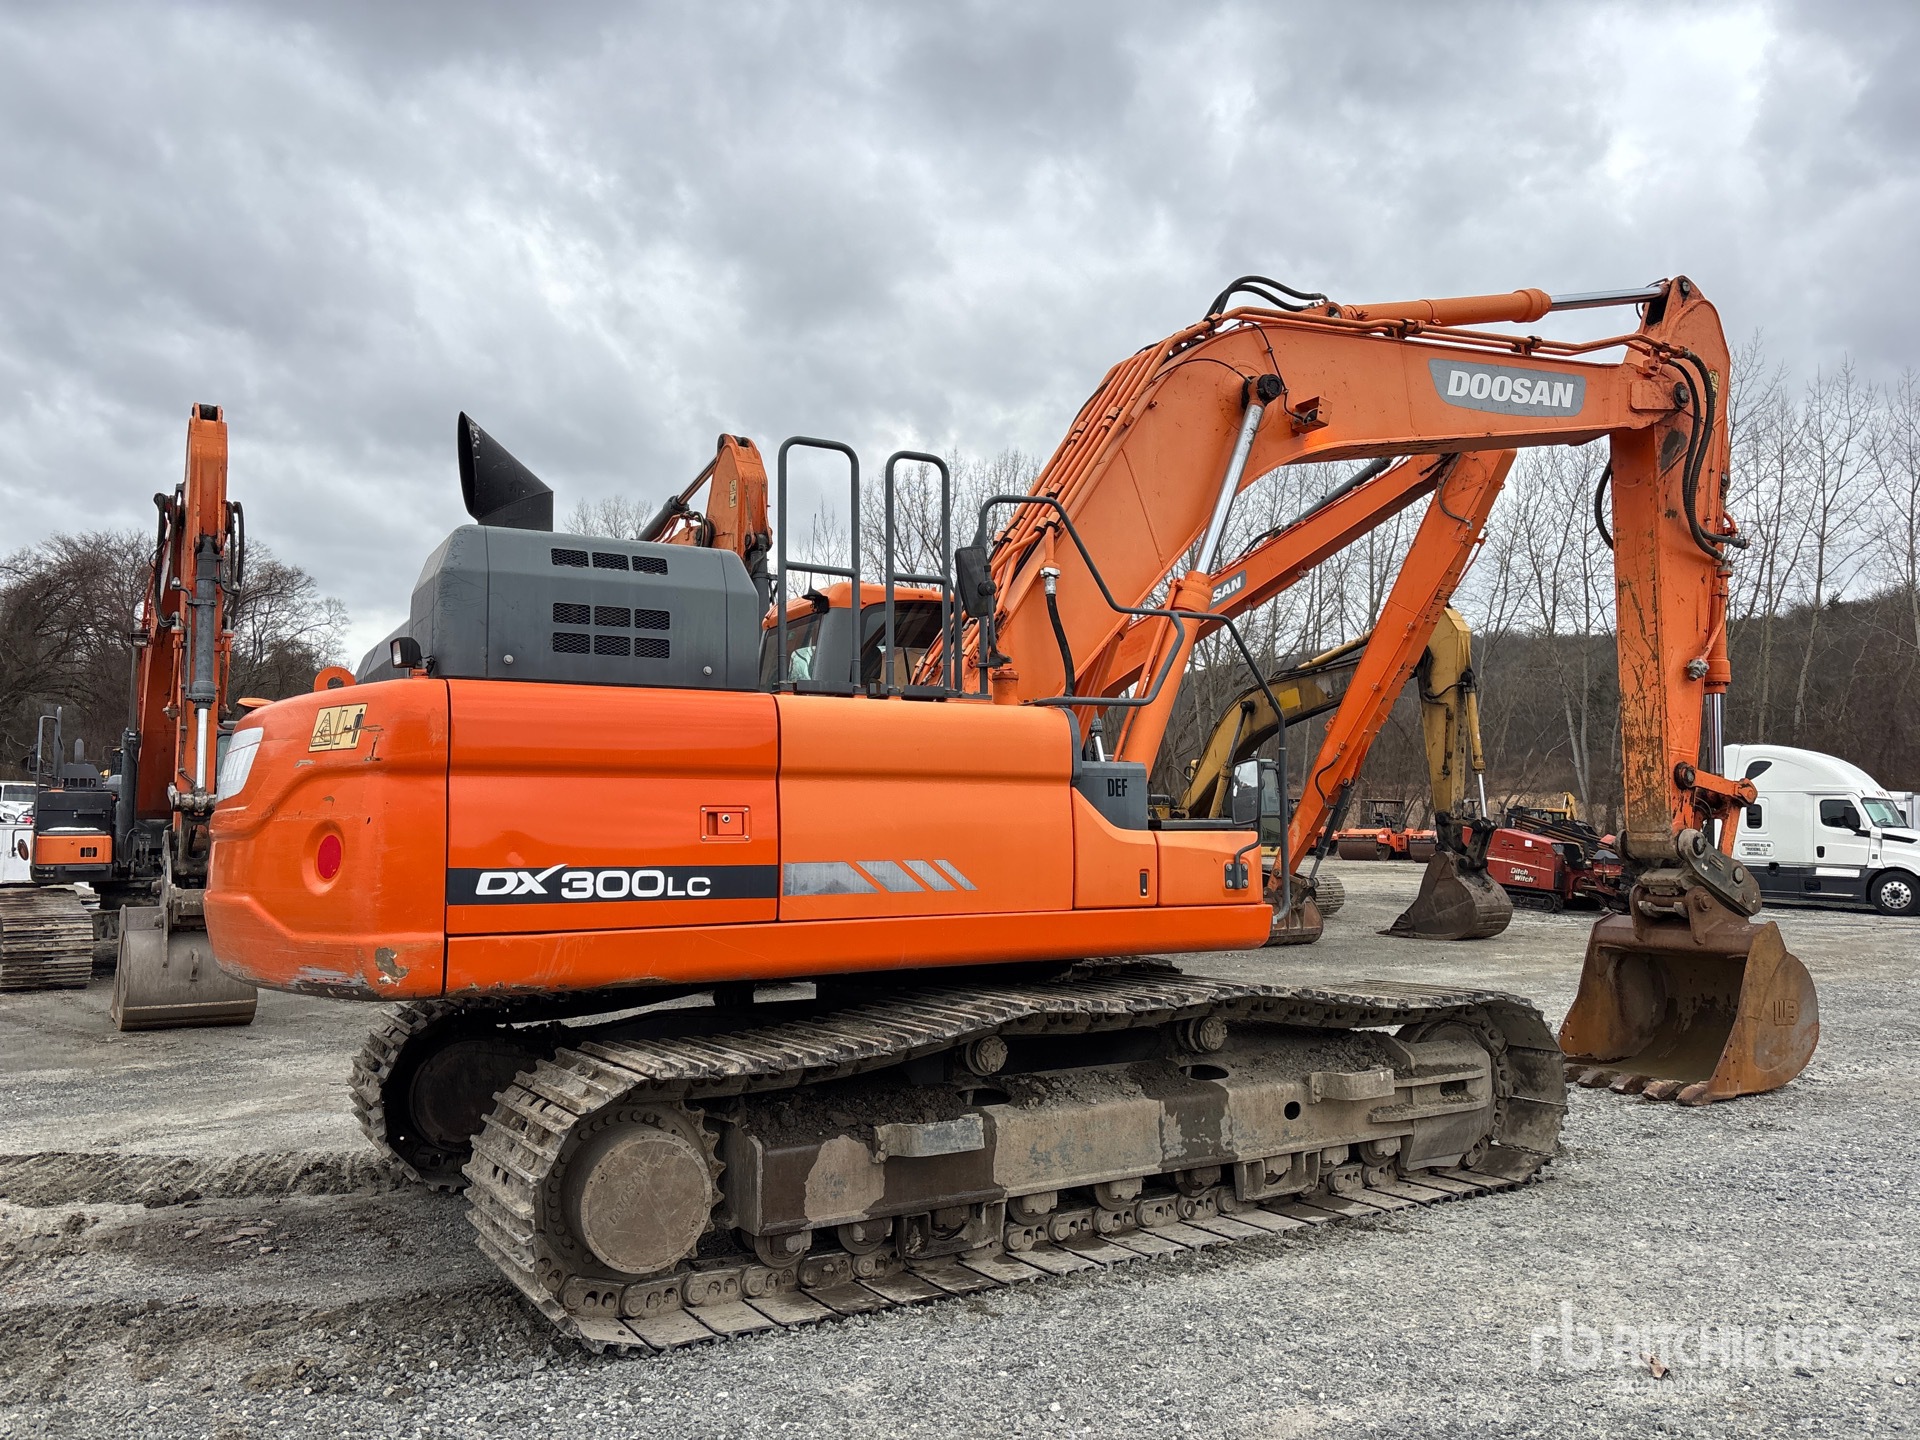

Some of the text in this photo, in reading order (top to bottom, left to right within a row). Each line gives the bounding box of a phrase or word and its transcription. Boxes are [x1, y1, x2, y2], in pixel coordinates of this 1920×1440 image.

[1447, 370, 1574, 408] DOOSAN
[1211, 576, 1242, 604] SAN
[1107, 778, 1128, 797] DEF
[1510, 867, 1529, 876] Ditch
[1514, 874, 1534, 883] Witch
